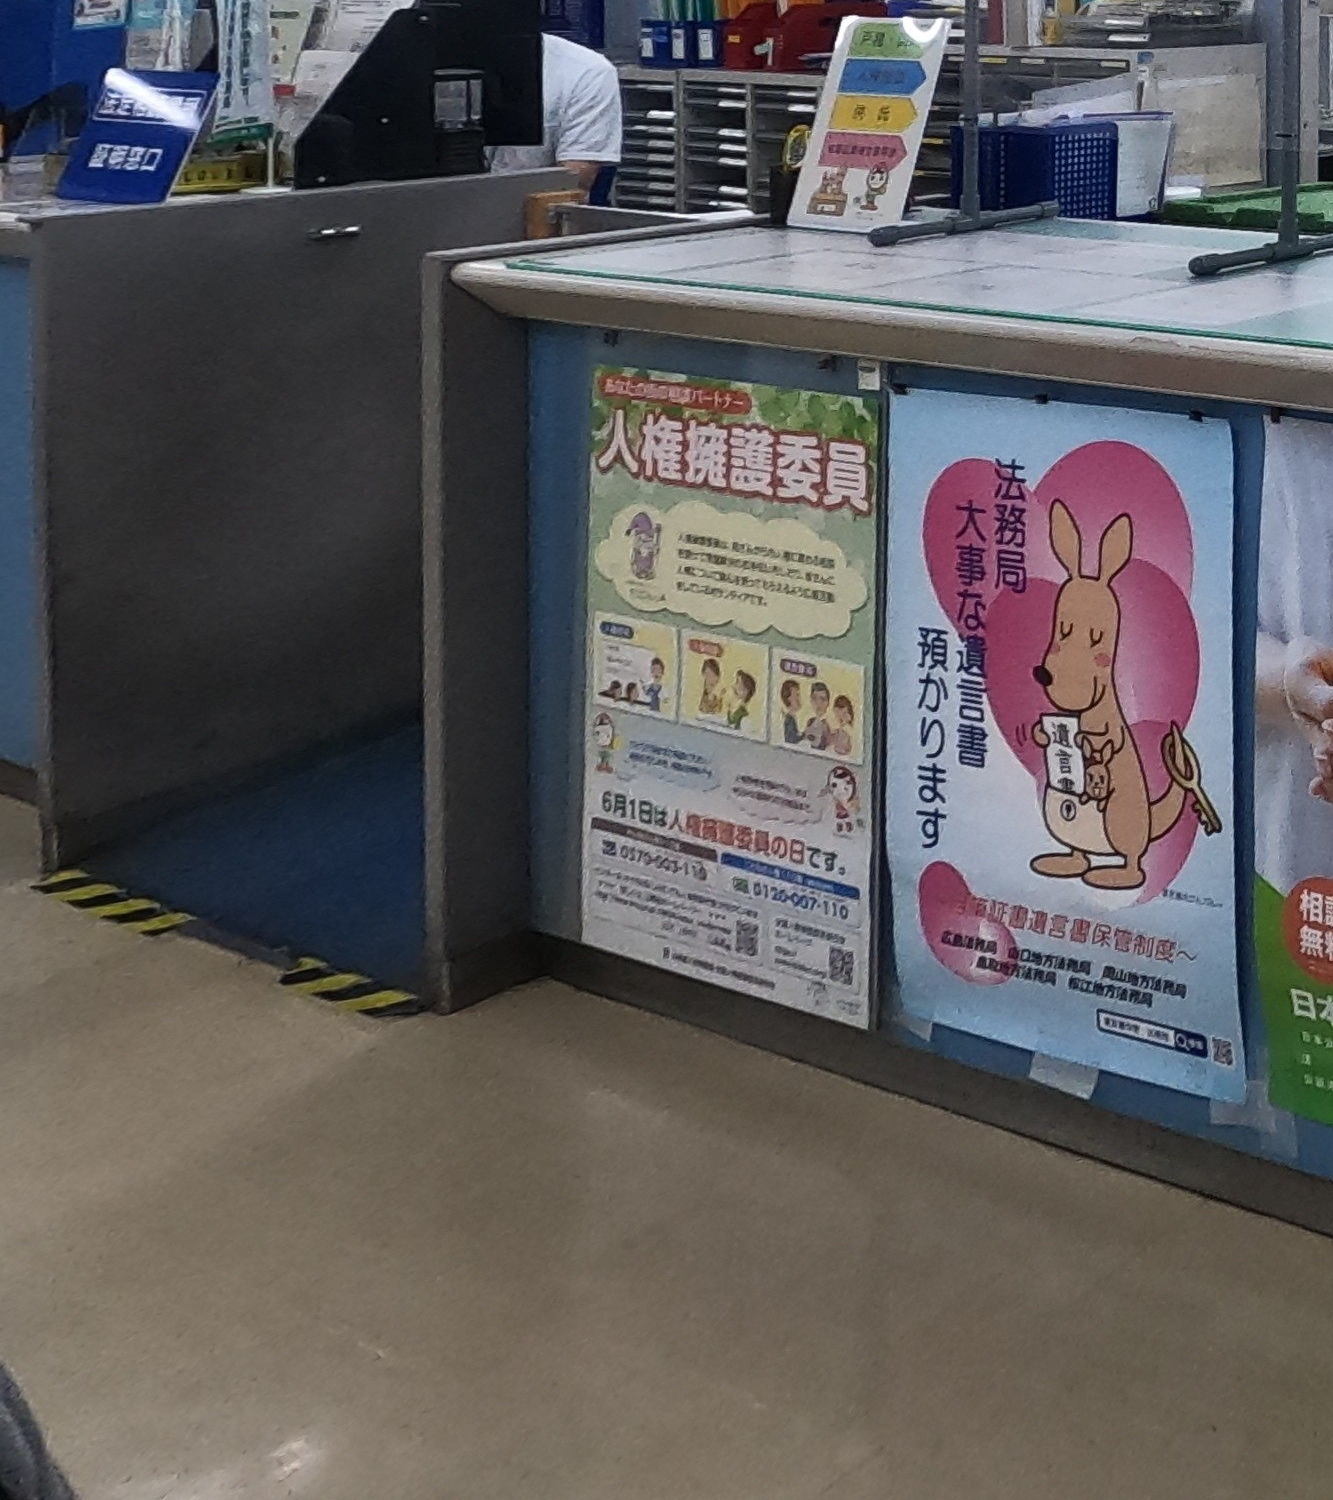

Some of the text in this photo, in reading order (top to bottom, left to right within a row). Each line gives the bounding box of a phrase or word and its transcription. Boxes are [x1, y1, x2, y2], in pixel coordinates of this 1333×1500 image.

[598, 409, 870, 512] 人権擁護委員
[994, 458, 1026, 593] 法務局
[955, 499, 989, 769] 大事な遺言書
[916, 626, 949, 849] 預かります
